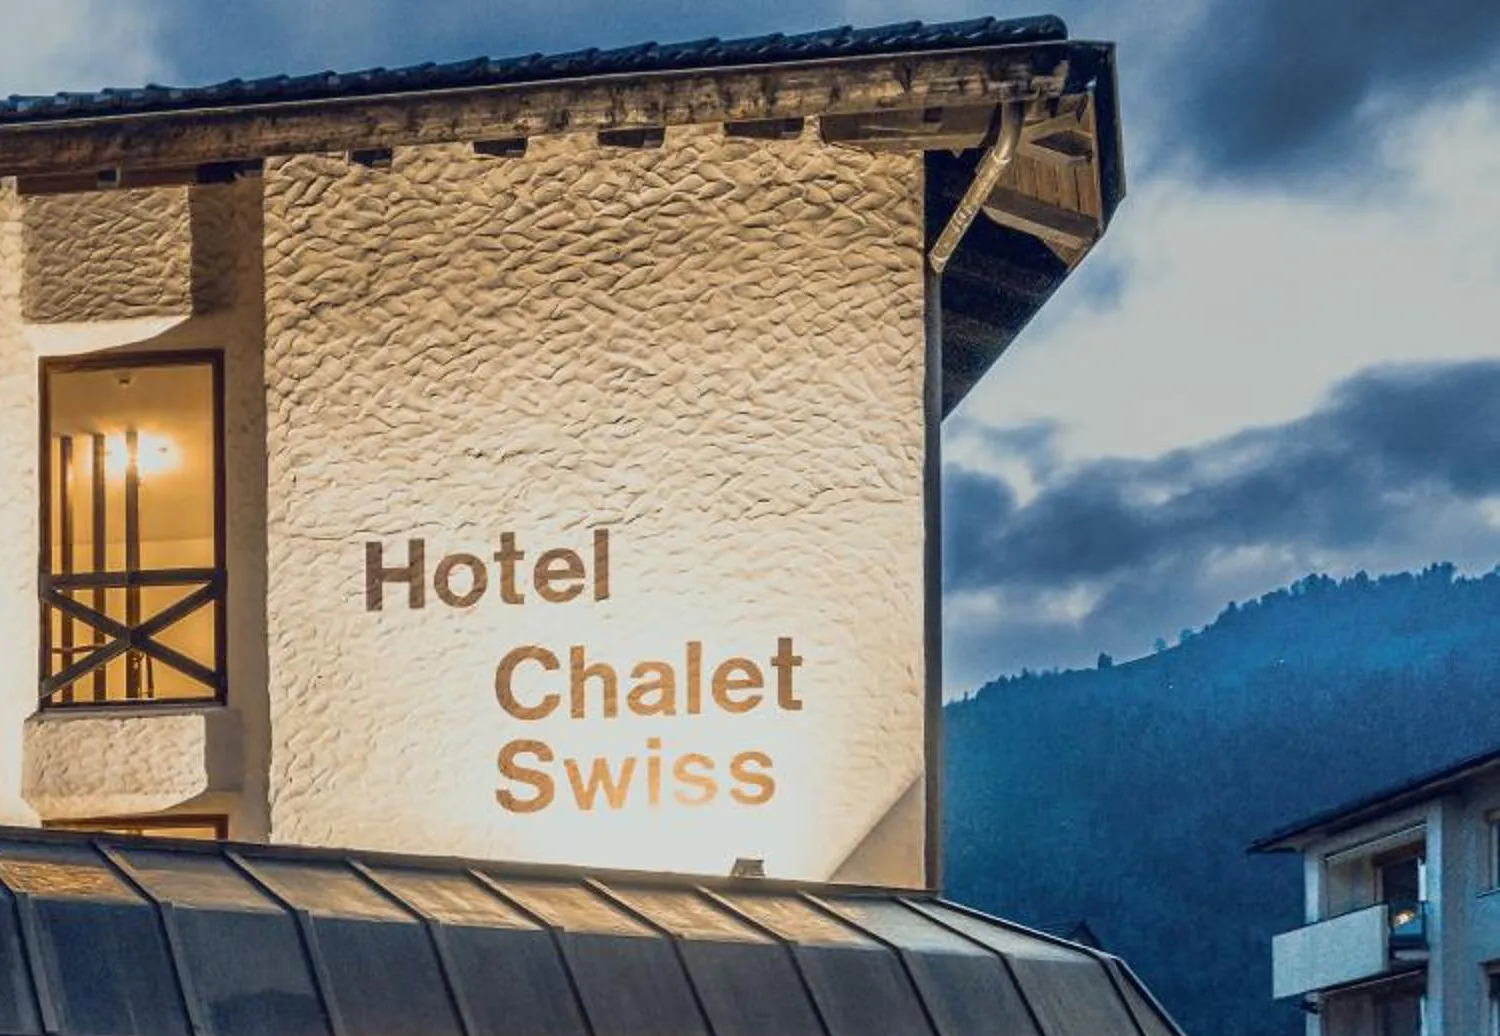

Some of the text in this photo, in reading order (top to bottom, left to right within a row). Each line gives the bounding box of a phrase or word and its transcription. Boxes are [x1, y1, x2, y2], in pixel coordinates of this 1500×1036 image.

[365, 528, 611, 611] Hotel
[494, 636, 803, 721] Chalet
[494, 736, 777, 814] Swiss
